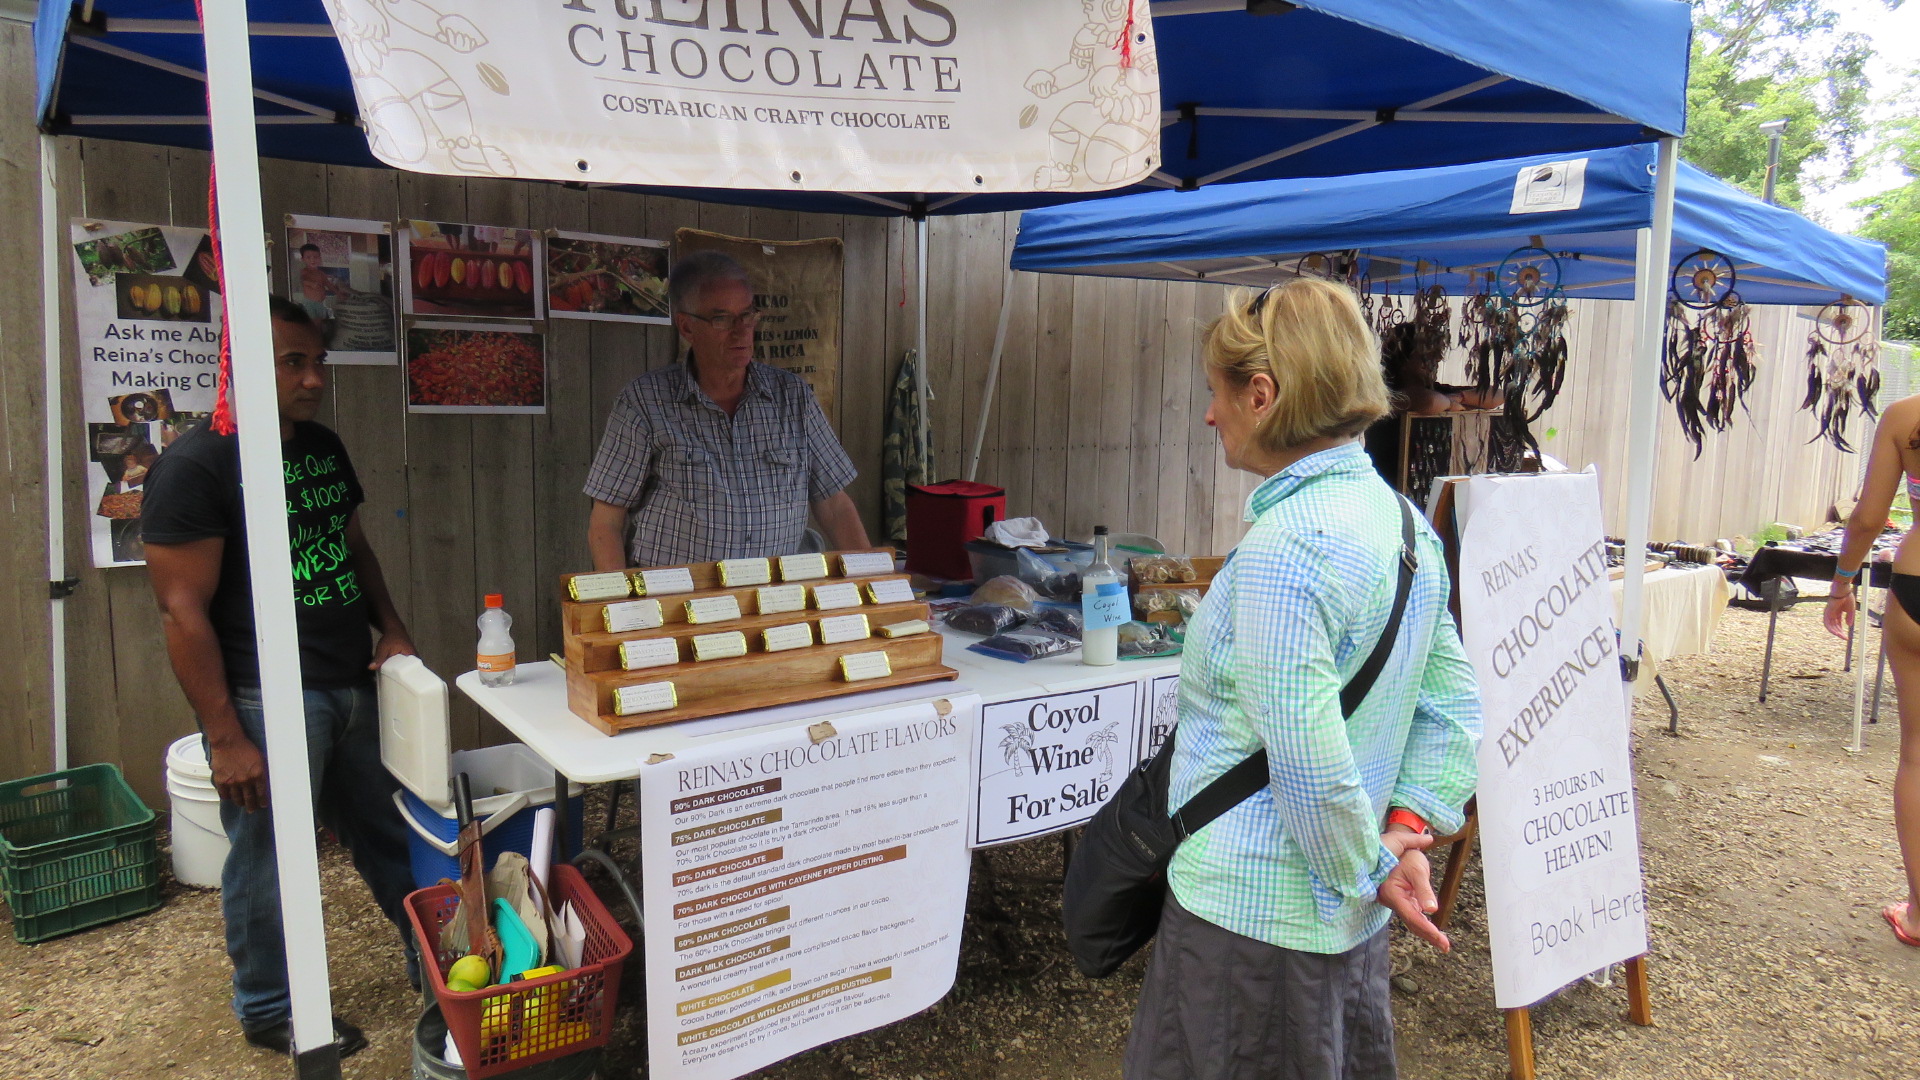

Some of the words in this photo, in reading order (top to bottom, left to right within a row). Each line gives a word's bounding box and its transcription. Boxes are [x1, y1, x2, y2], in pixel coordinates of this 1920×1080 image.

[567, 23, 962, 93] CHOCOLATE
[602, 93, 748, 122] COSTARICAN
[753, 107, 825, 127] CRAFT
[830, 111, 951, 130] CHOCOLATE
[752, 294, 789, 308] ACAO
[104, 323, 145, 341] Ask
[151, 328, 182, 341] me
[93, 346, 163, 363] Reina's
[168, 349, 221, 364] Choc
[769, 344, 806, 358] RICA
[112, 370, 191, 391] Making
[196, 372, 217, 388] Cl
[305, 454, 336, 477] QUIE
[328, 514, 347, 534] BE
[1480, 544, 1539, 598] REINA'S
[1093, 599, 1119, 612] Coyol
[1103, 614, 1122, 623] Wine
[1491, 539, 1607, 680] CHOCOLATE
[1027, 694, 1100, 734] Coyol
[678, 756, 752, 791] REINA'S
[760, 731, 878, 774] CHOCOLATE
[885, 715, 956, 748] FLAVORS
[1028, 743, 1095, 776] Wine
[674, 815, 687, 825] Our
[690, 811, 706, 821] 90%
[708, 807, 724, 817] Dark
[726, 805, 732, 813] is
[745, 796, 771, 809] extreme
[773, 793, 787, 802] dark
[789, 786, 819, 799] chocolate
[821, 783, 832, 792] that
[834, 778, 854, 790] people
[869, 773, 884, 781] more
[886, 767, 903, 777] edible
[905, 764, 918, 772] than
[919, 761, 930, 771] they
[674, 800, 690, 811] 90%
[692, 795, 715, 807] DARK
[717, 784, 764, 801] CHOCOLATE
[1006, 793, 1056, 825] For
[1059, 778, 1110, 813] Sale
[1532, 788, 1541, 806] 3
[1543, 773, 1588, 803] HOURS
[1590, 768, 1606, 788] IN
[675, 847, 688, 857] Our
[691, 843, 708, 853] most
[710, 836, 735, 850] popular
[738, 828, 768, 842] chocolate
[772, 826, 777, 834] in
[779, 823, 789, 832] the
[791, 815, 823, 829] Tamarindo
[850, 806, 861, 815] has
[878, 800, 890, 808] less
[892, 797, 908, 806] sugar
[909, 792, 921, 801] than
[675, 833, 691, 843] 75%
[693, 827, 715, 839] DARK
[718, 816, 765, 833] CHOCOLATE
[1523, 791, 1630, 845] CHOCOLATE
[676, 872, 692, 883] 70%
[694, 866, 717, 878] DARK
[720, 854, 766, 872] CHOCOLATE
[677, 886, 692, 897] 70%
[695, 882, 710, 892] dark
[712, 880, 718, 888] is
[720, 877, 730, 886] the
[733, 870, 755, 882] default
[757, 862, 784, 876] standard
[787, 858, 800, 868] dark
[802, 850, 832, 864] chocolate
[834, 846, 850, 856] made
[853, 843, 859, 852] by
[861, 839, 876, 849] most
[877, 831, 911, 845] bean-to-bar
[913, 823, 939, 836] chocolate
[1544, 829, 1613, 875] HEAVEN!
[677, 904, 693, 915] 70%
[695, 898, 718, 910] DARK
[720, 885, 766, 904] CHOCOLATE
[768, 880, 786, 891] WITH
[788, 870, 821, 885] CAYENNE
[824, 862, 851, 875] PEPPER
[853, 854, 883, 867] DUSTING
[678, 920, 690, 929] For
[692, 914, 711, 926] those
[713, 910, 727, 920] with
[735, 903, 752, 914] need
[754, 900, 762, 909] for
[678, 937, 694, 948] 60%
[696, 930, 718, 942] DARK
[721, 916, 767, 935] CHOCOLATE
[1530, 905, 1585, 956] Book
[1590, 890, 1644, 930] Here
[679, 951, 692, 961] The
[695, 946, 710, 957] 60%
[713, 941, 728, 952] Dark
[730, 931, 763, 946] Chocolate
[765, 924, 784, 937] brings
[787, 921, 796, 930] out
[799, 913, 822, 926] different
[825, 906, 850, 918] nuances
[679, 965, 703, 978] DARK
[704, 959, 723, 971] MILK
[725, 944, 771, 965] CHOCOLATE
[680, 984, 685, 992] A
[687, 974, 721, 990] wonderful
[723, 967, 747, 981] creamy
[749, 960, 763, 971] treat
[765, 956, 778, 966] with
[785, 949, 801, 959] more
[803, 936, 839, 955] complicated
[841, 932, 858, 942] cacao
[861, 925, 878, 936] flavor
[680, 999, 706, 1013] WHITE
[708, 983, 754, 1005] CHOCOLATE
[681, 1030, 707, 1044] WHITE
[709, 1014, 755, 1036] CHOCOLATE
[757, 1007, 775, 1019] WITH
[776, 994, 810, 1012] CAYENNE
[812, 985, 839, 999] PEPPER
[841, 975, 872, 990] DUSTING
